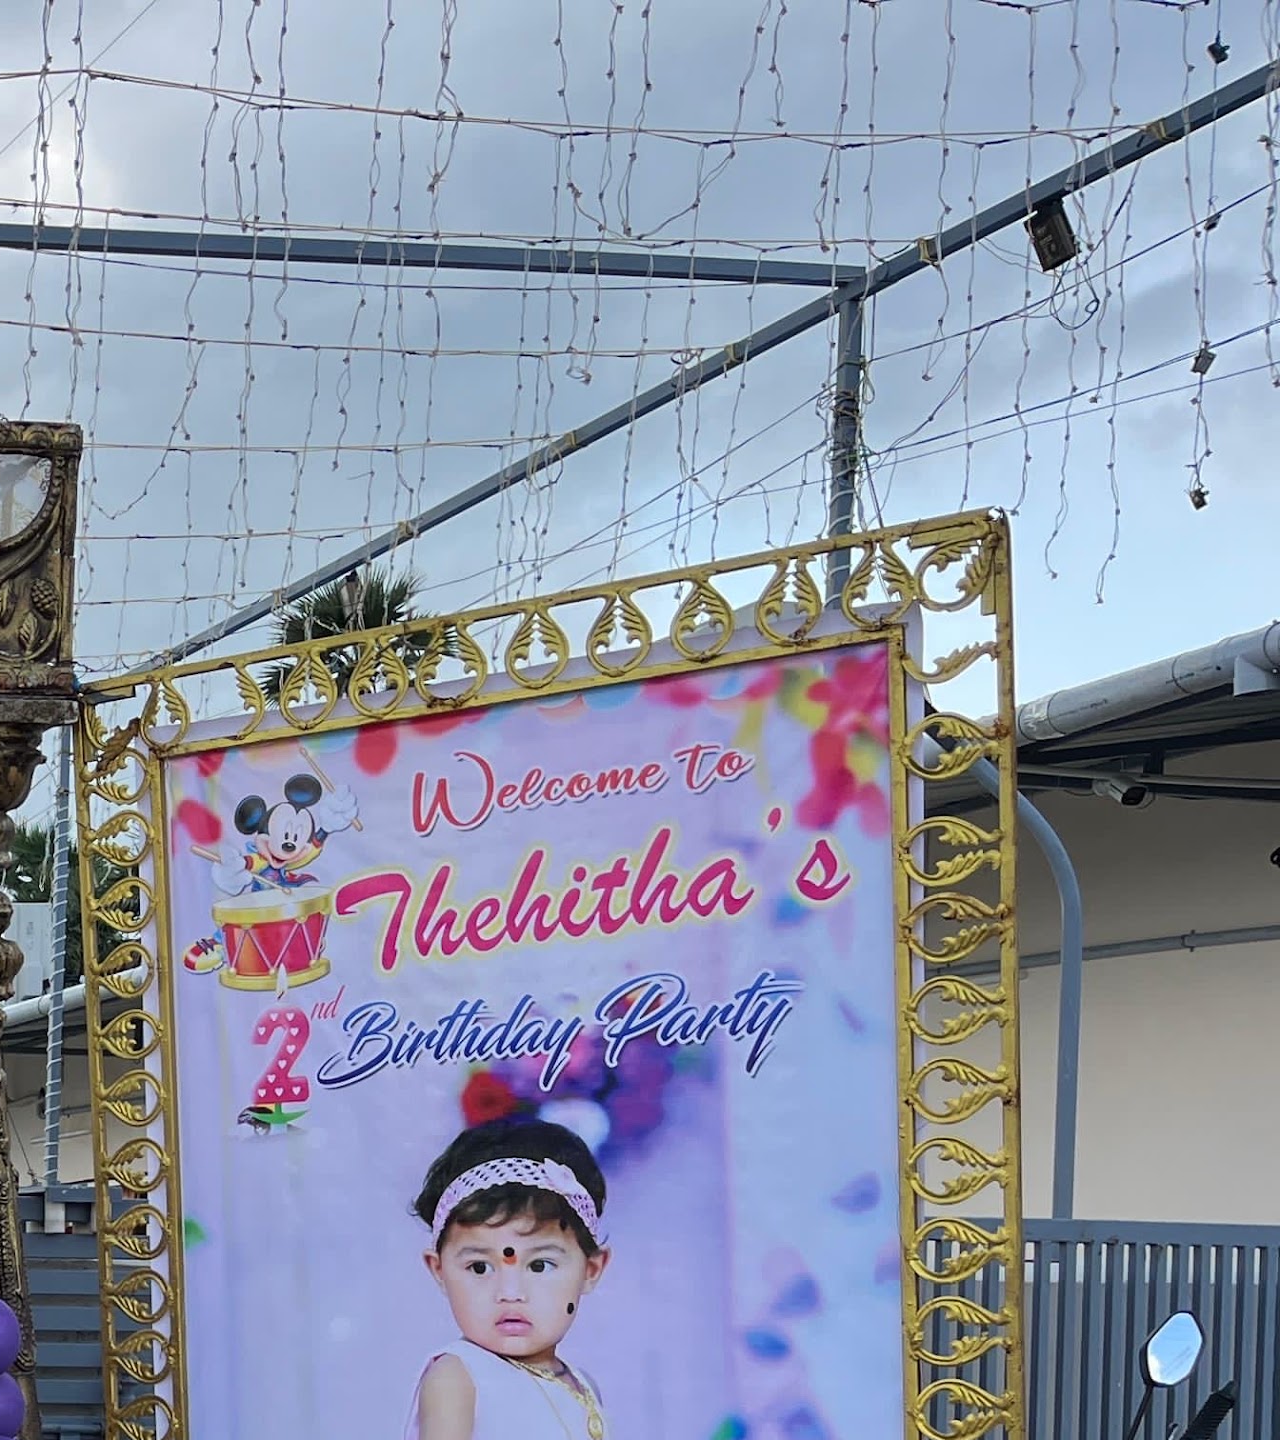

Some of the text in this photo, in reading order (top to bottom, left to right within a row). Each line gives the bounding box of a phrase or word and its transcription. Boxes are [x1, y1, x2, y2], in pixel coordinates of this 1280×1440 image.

[411, 750, 668, 836] Welcome
[334, 806, 852, 972] Thehitha's
[316, 994, 586, 1090] Birthday
[594, 969, 805, 1076] Party
